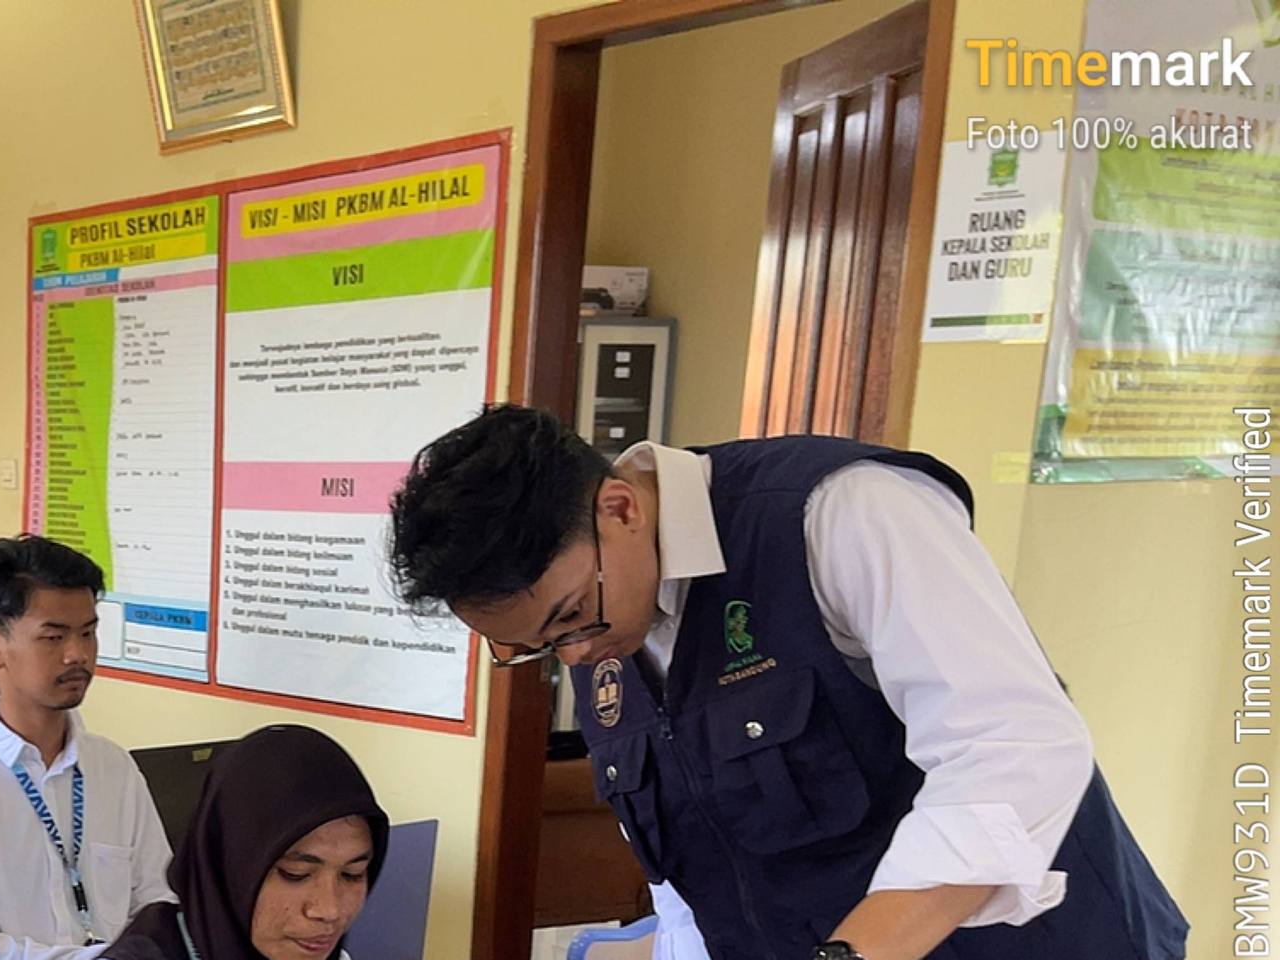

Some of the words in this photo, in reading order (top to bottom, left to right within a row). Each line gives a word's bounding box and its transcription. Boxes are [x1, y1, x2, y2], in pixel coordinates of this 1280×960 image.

[249, 207, 278, 230] VISI
[293, 199, 326, 223] MISI
[336, 189, 385, 217] PKBM
[388, 175, 471, 208] AL-HILAL
[70, 220, 122, 245] PROFIL
[126, 206, 207, 237] SEKOLAH
[968, 208, 1026, 233] RUANG
[941, 237, 987, 256] KEPALA
[989, 232, 1051, 253] SEKOLAH
[80, 250, 110, 269] PKBM
[947, 260, 981, 281] DAN
[984, 257, 1033, 280] GURU
[332, 263, 365, 287] VISI
[321, 477, 355, 498] MISI
